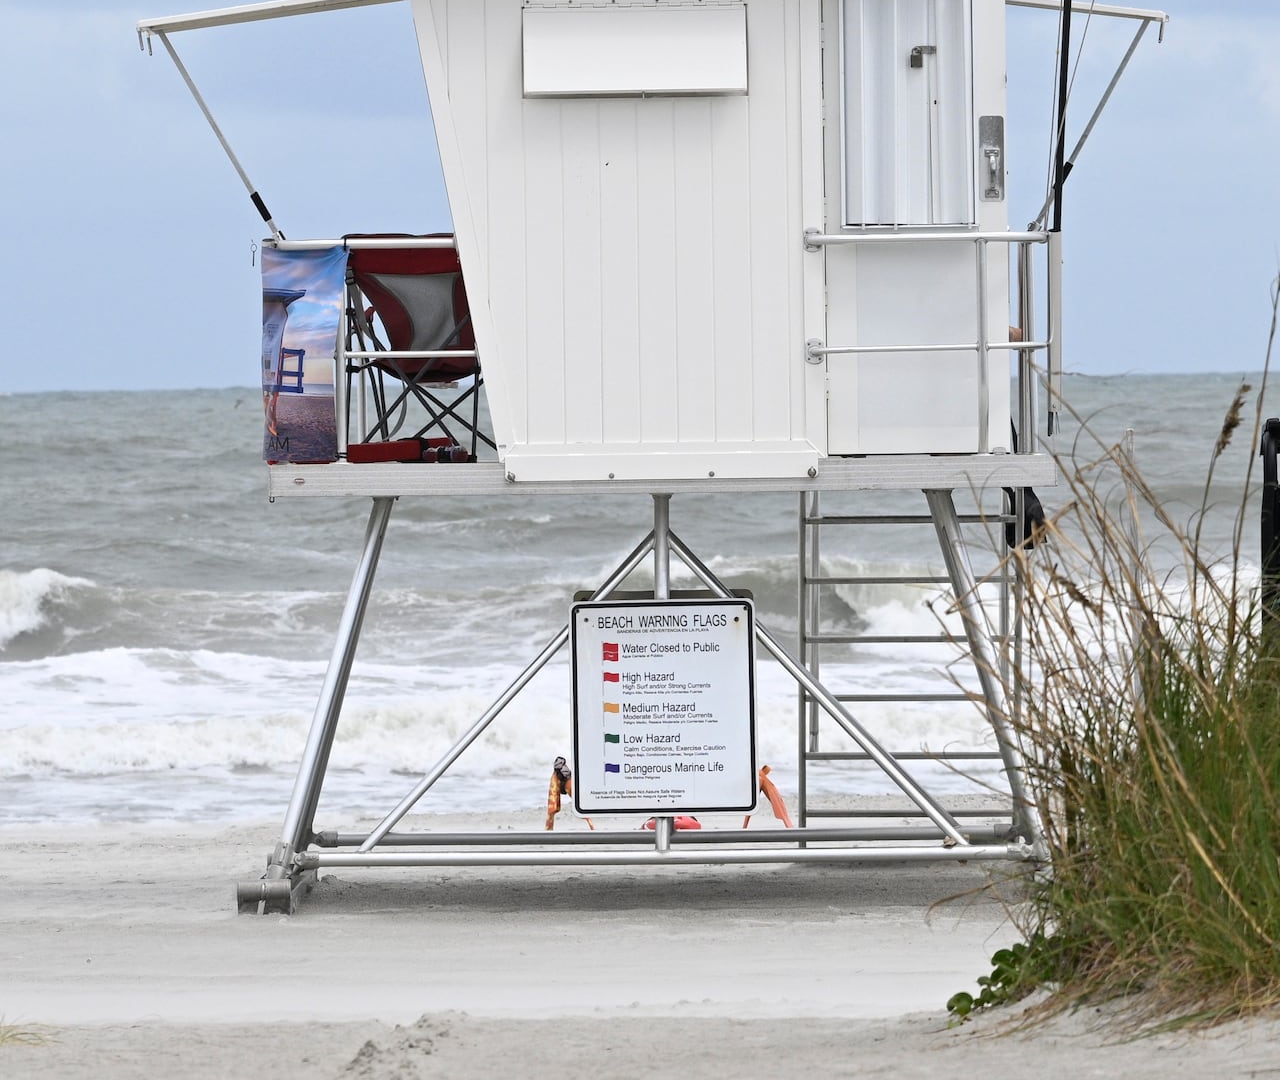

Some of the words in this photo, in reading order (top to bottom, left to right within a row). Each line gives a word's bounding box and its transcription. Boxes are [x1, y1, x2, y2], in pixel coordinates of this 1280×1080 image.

[598, 616, 632, 628] BEACH
[639, 615, 687, 628] WARNING
[694, 615, 727, 626] FLAGS
[622, 644, 647, 653] Water
[650, 643, 679, 652] Closed
[683, 644, 690, 652] to
[694, 643, 720, 652] Public
[622, 673, 641, 684] High
[644, 672, 674, 681] Hazard
[623, 703, 659, 712] Medium
[663, 702, 695, 712] Hazard
[624, 734, 643, 743] Low
[646, 733, 680, 743] Hazard
[624, 764, 672, 775] Dangerous
[675, 762, 704, 772] Marine
[708, 762, 724, 771] Life
